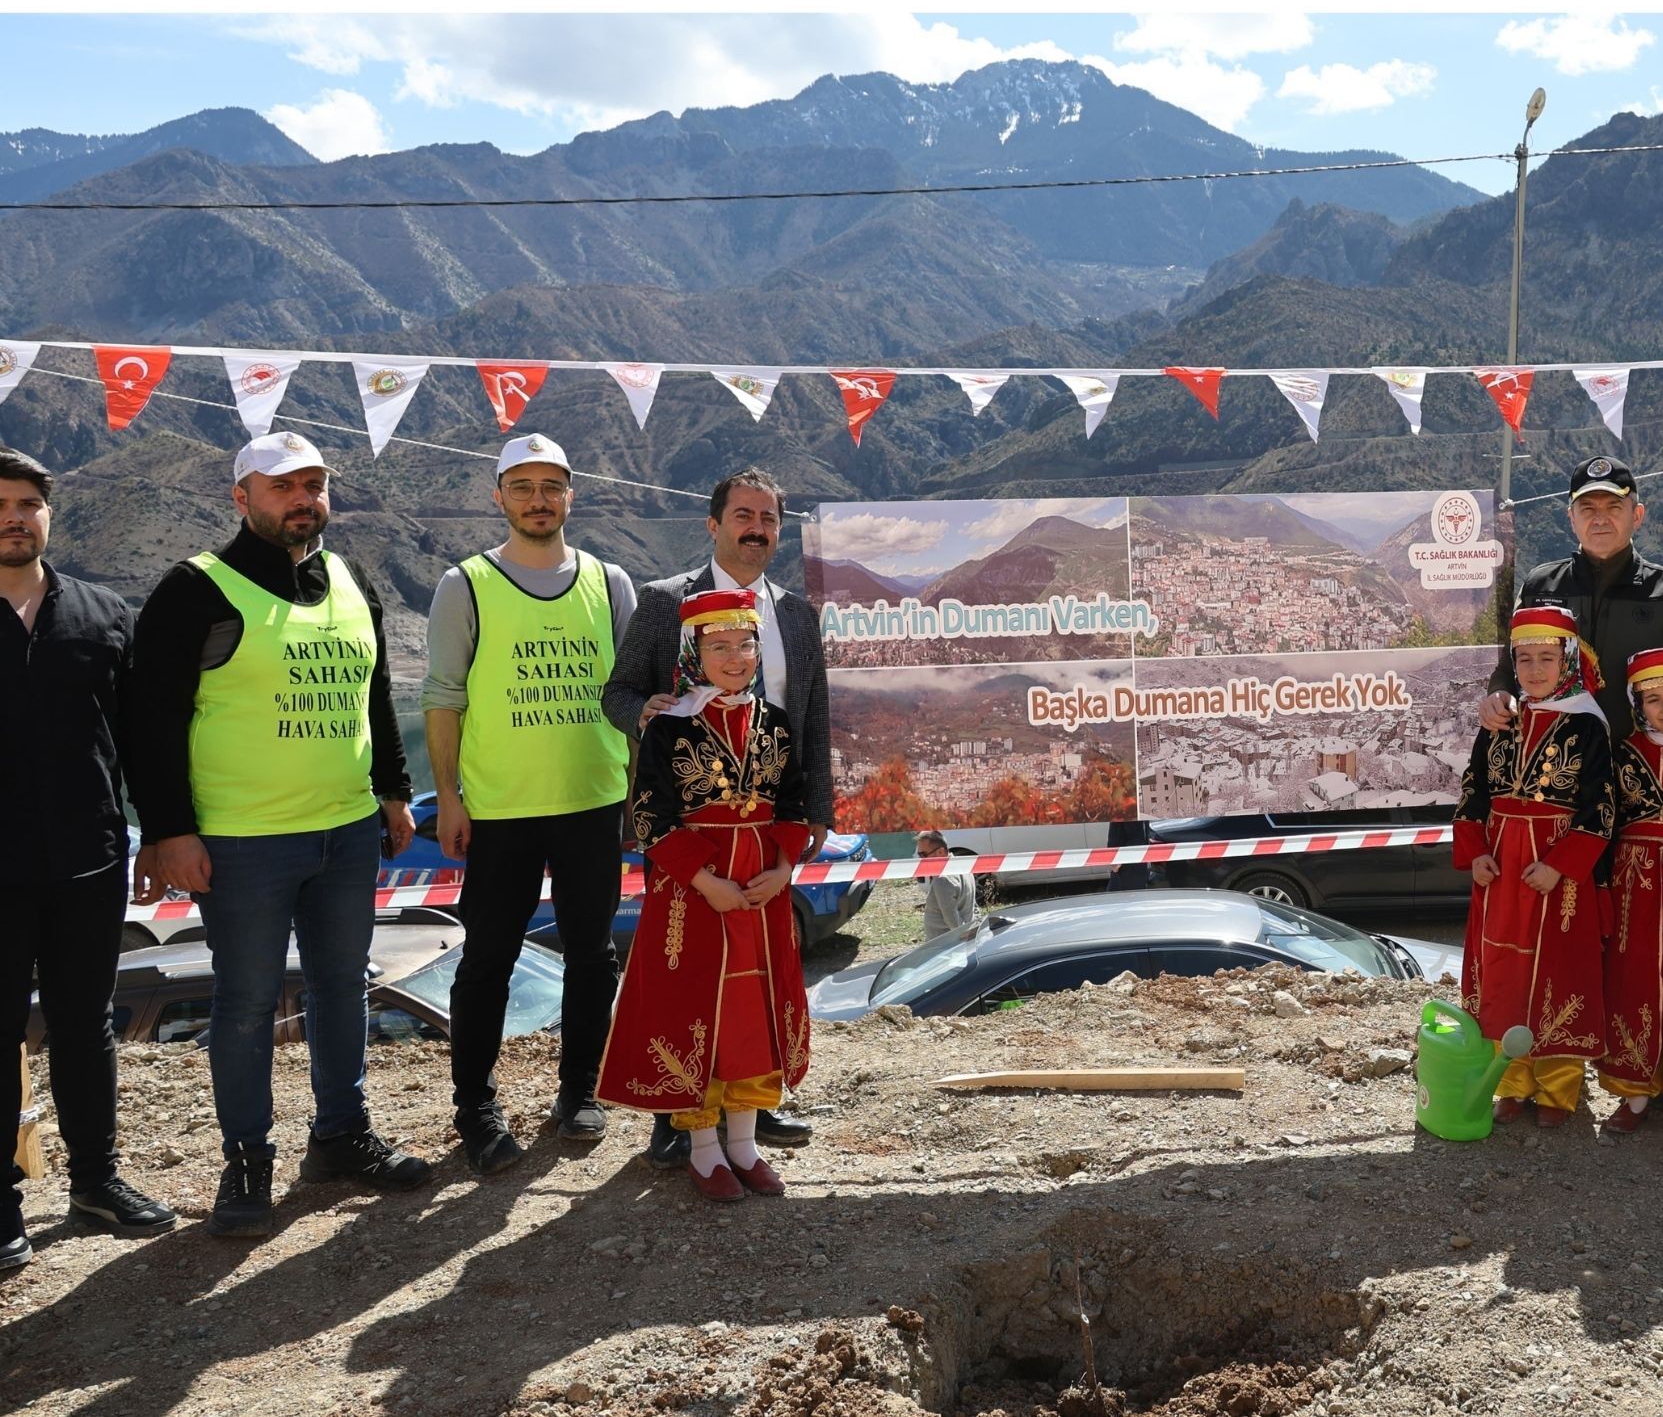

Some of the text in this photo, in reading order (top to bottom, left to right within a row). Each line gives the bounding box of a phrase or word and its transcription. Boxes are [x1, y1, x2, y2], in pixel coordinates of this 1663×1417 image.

[1415, 548, 1498, 560] T.C. SAĞLIK BAKANLIĞI
[942, 602, 1048, 634] Dumanı
[1052, 596, 1156, 634] Varken,
[283, 637, 372, 660] ARTVİNİN
[511, 636, 599, 659] ARTVİNİN
[289, 666, 369, 685] SAHASI
[517, 662, 594, 680] SAHASI
[275, 692, 314, 712] %100
[506, 685, 602, 705] %100 DUMANSIZ
[1031, 674, 1410, 727] Başka Dumana Hiç Gerek Yok.
[511, 708, 602, 727] HAVA SAHASI
[278, 720, 326, 738] HAVA
